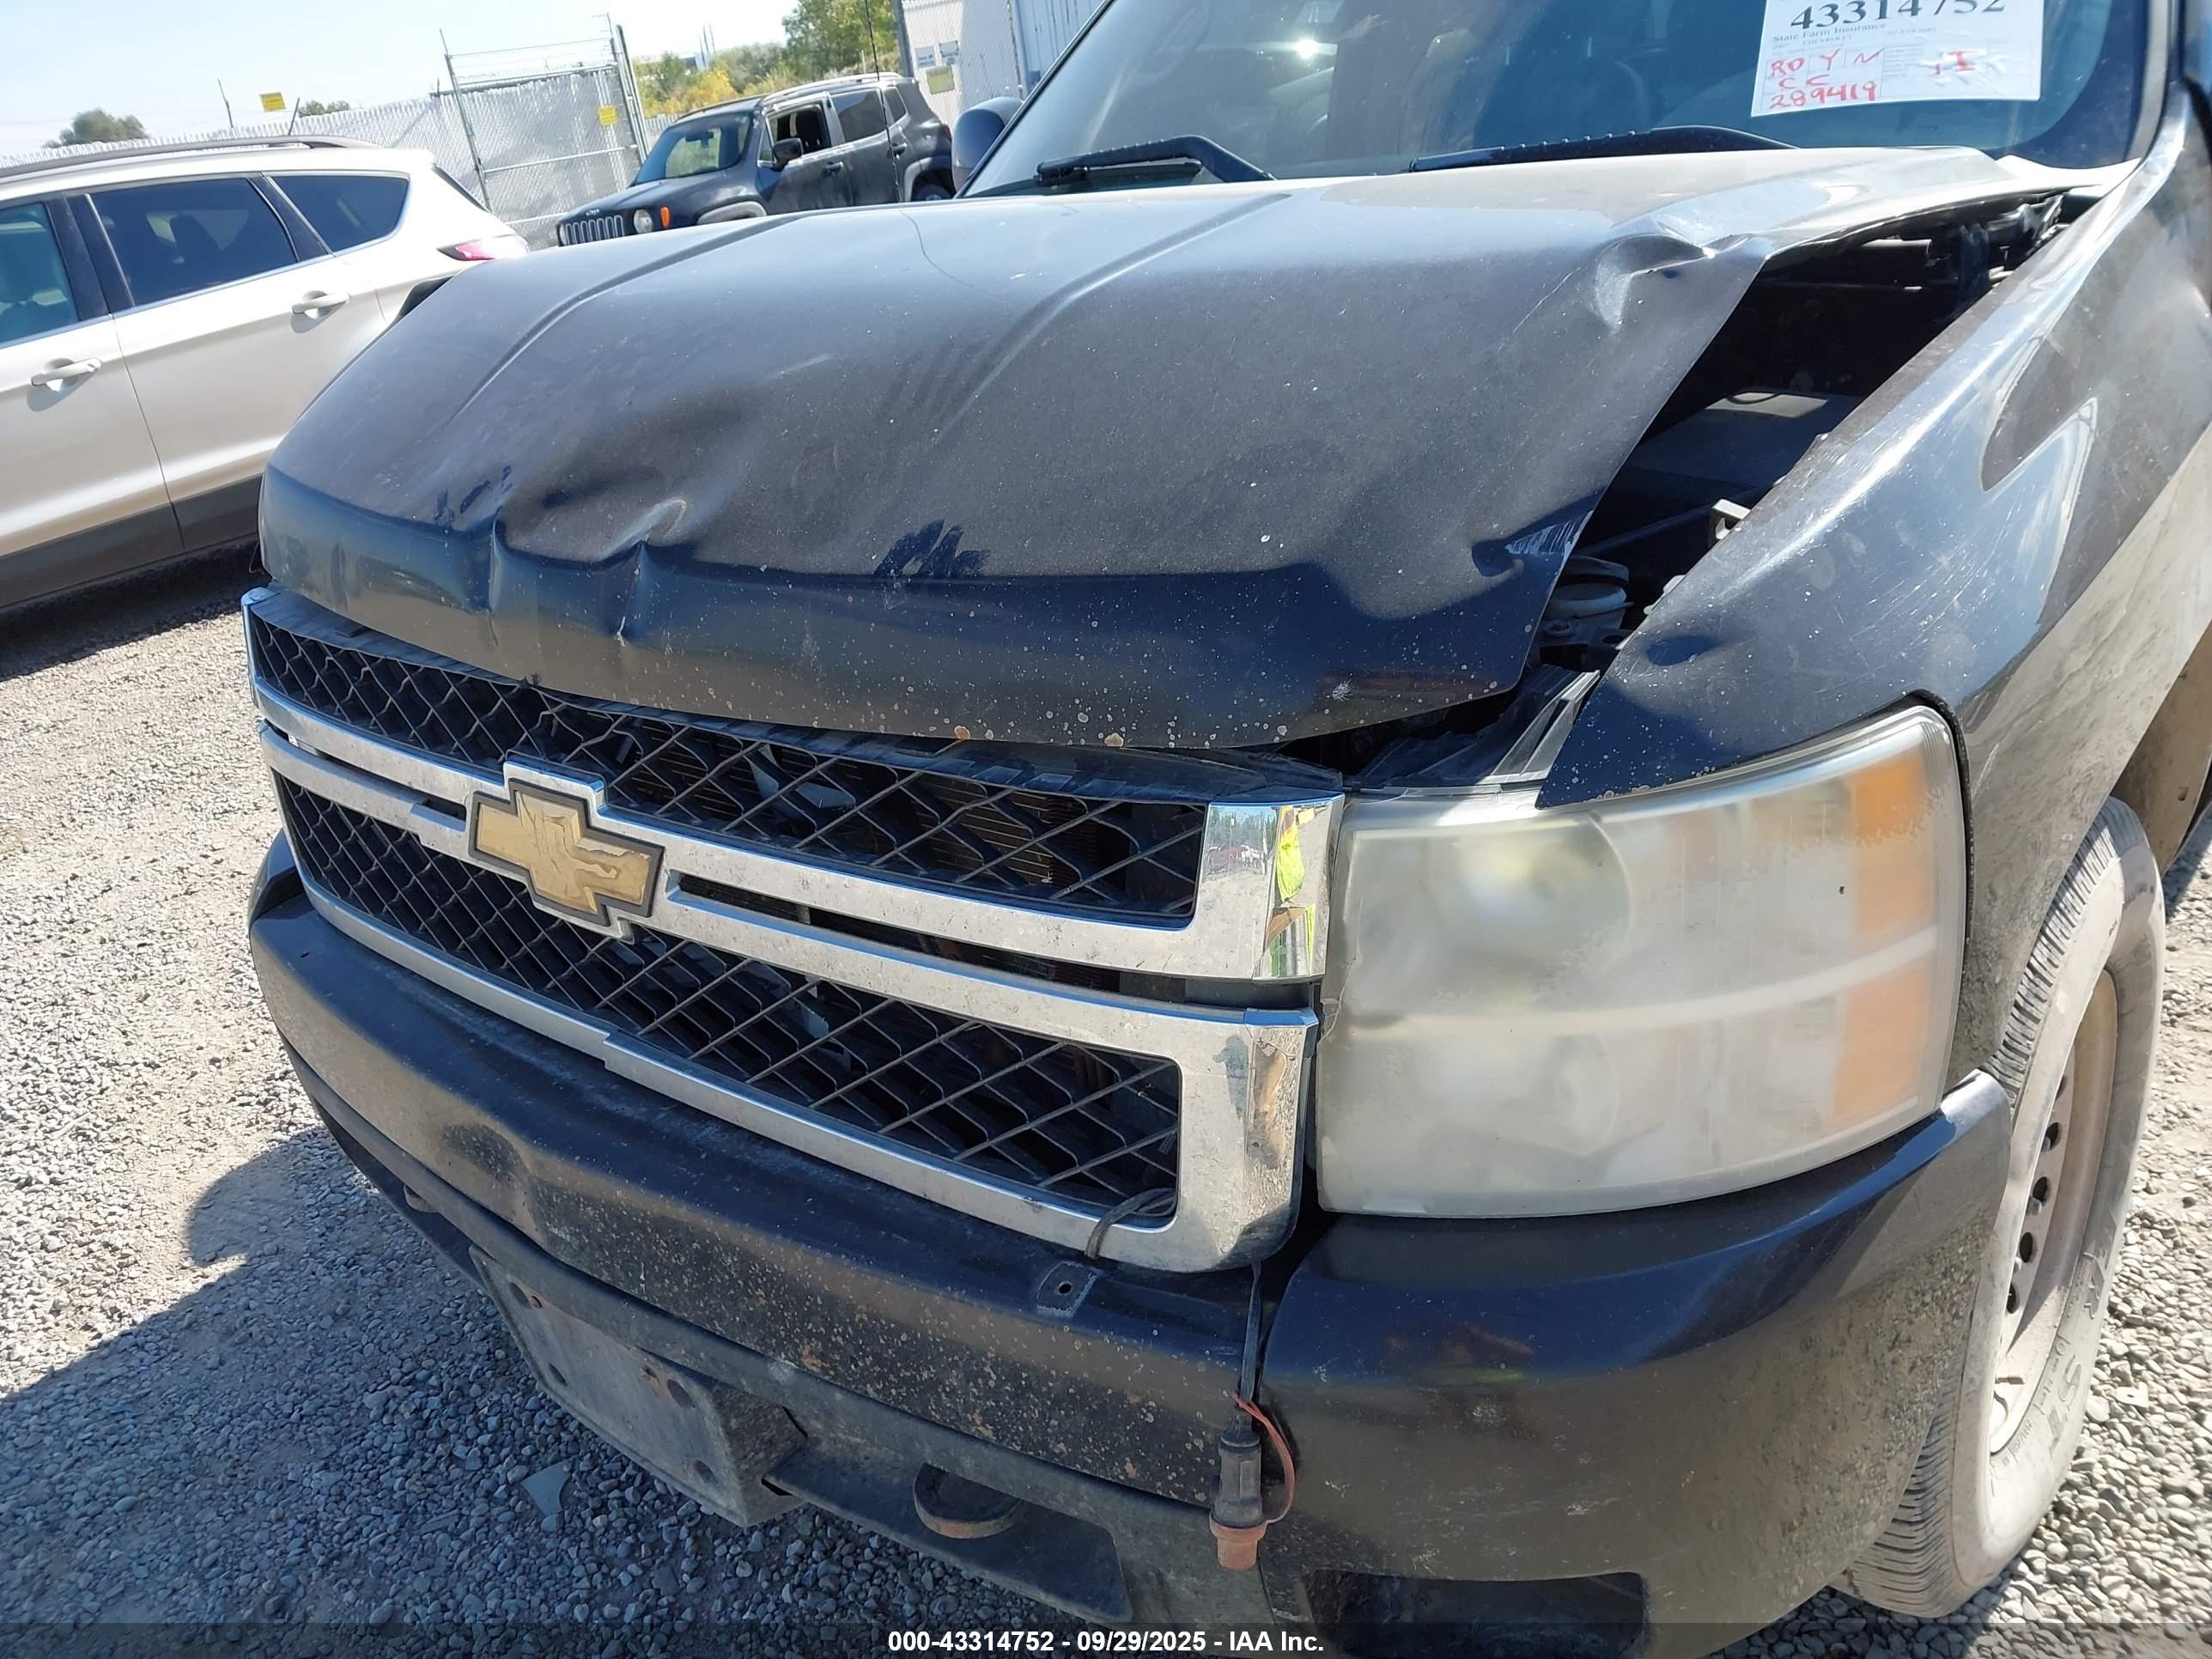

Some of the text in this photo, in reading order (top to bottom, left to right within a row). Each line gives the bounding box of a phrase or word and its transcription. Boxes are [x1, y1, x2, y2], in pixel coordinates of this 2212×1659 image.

[1772, 33, 1799, 42] State
[1803, 28, 1831, 39] Farm
[1834, 22, 1887, 33] Insurance
